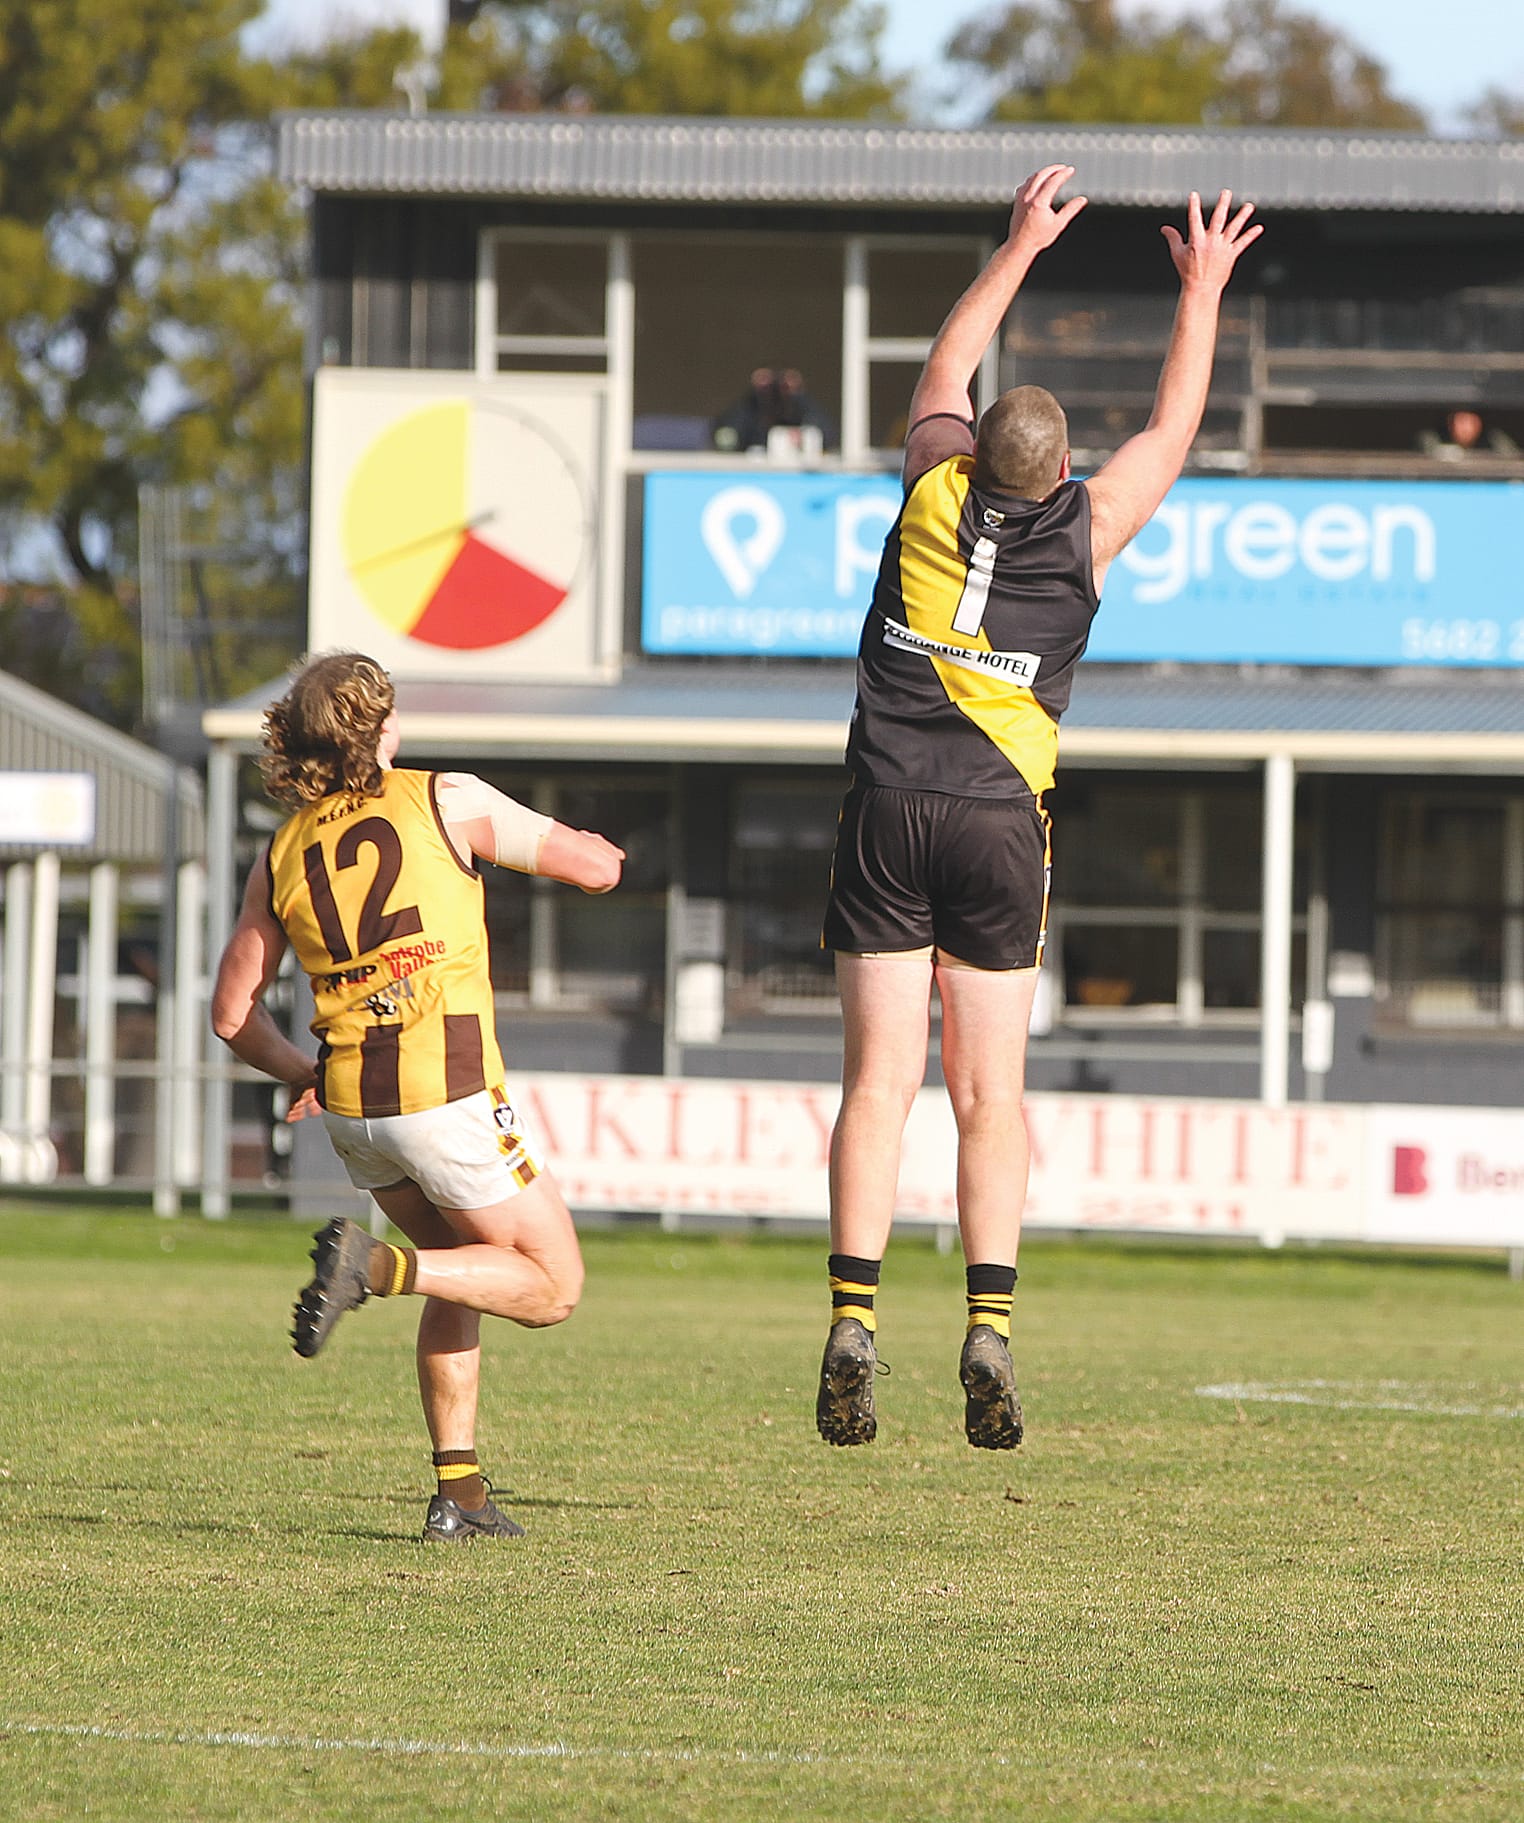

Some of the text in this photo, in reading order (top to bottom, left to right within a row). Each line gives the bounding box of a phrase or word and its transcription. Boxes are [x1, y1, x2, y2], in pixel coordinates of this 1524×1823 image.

[952, 536, 999, 637] 1
[977, 651, 1029, 678] HOTEL
[303, 816, 424, 965] 12
[516, 1080, 836, 1165] AKLEY
